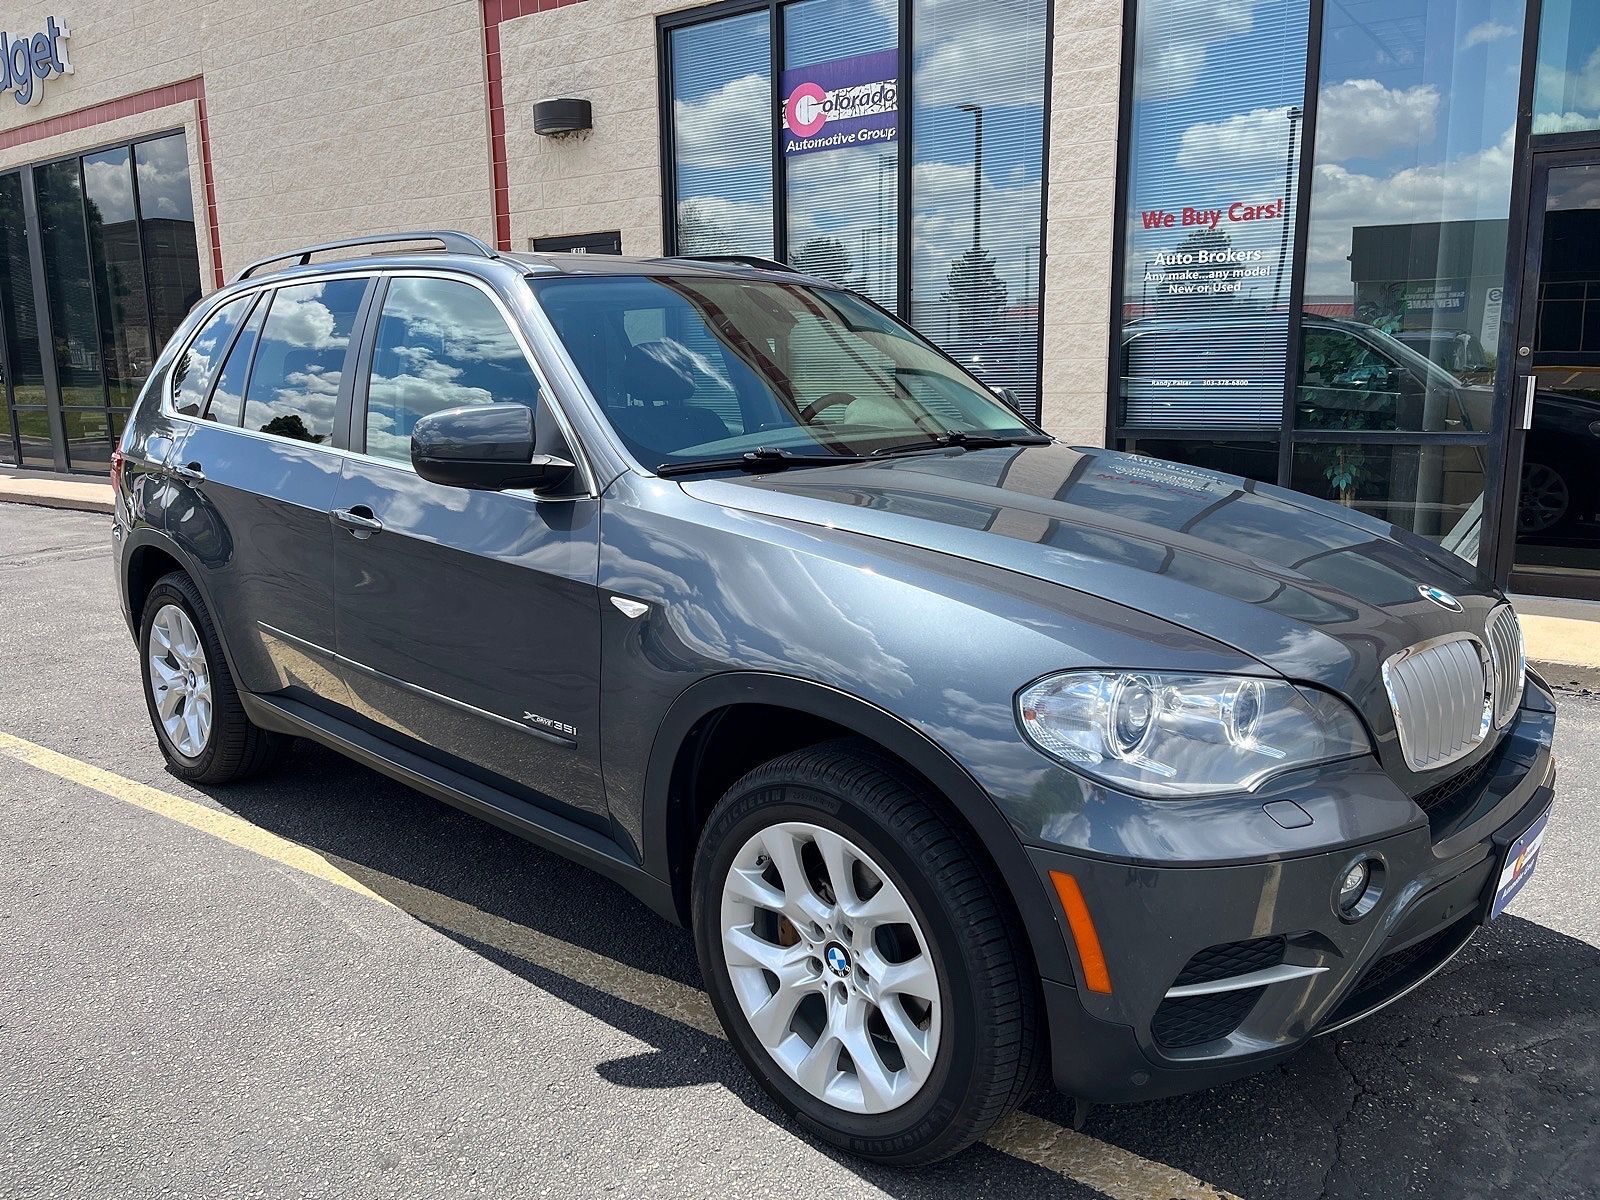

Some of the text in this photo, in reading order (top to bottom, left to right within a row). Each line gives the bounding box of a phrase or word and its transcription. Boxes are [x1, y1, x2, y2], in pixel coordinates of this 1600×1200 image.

[785, 82, 896, 138] Colorado
[785, 127, 897, 153] Automotive Group
[1141, 198, 1285, 230] We Buy Cars!
[1153, 247, 1263, 267] Auto Brokers
[1143, 272, 1166, 283] Any
[1232, 265, 1272, 278] model
[1168, 281, 1242, 295] New or Used
